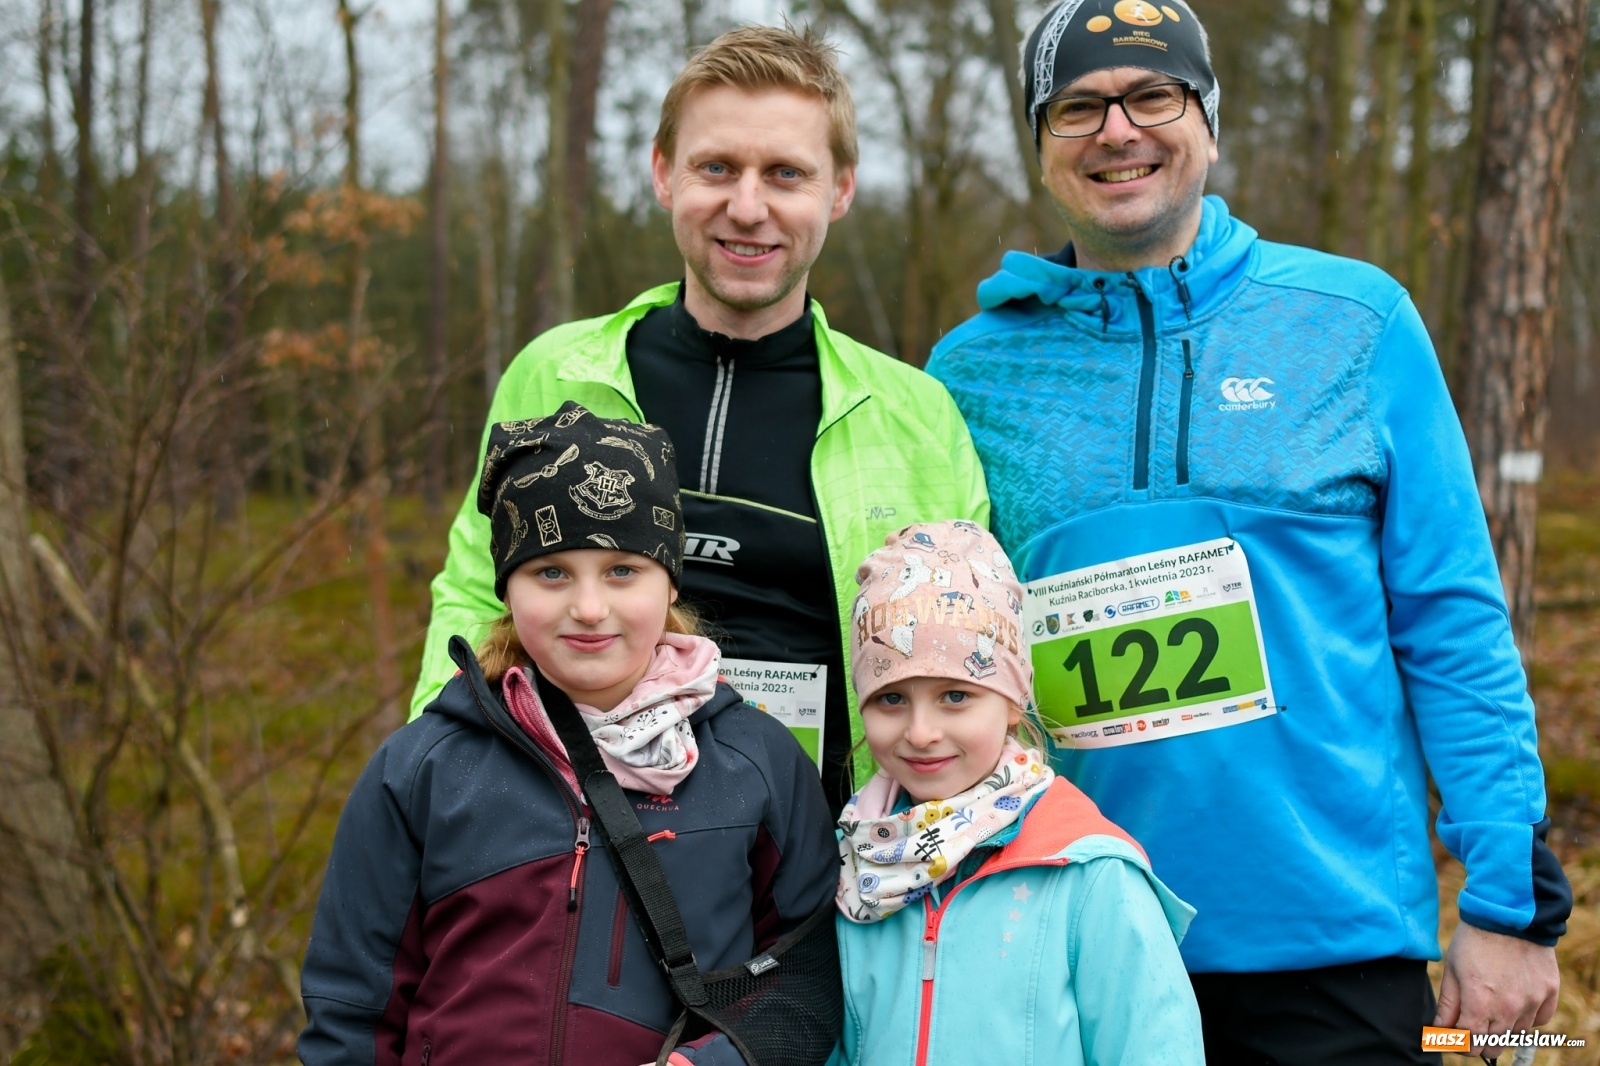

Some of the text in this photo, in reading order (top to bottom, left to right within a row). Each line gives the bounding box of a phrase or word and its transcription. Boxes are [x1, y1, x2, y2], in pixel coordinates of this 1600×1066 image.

[1219, 401, 1276, 411] canterbury
[865, 506, 897, 520] MP
[1033, 546, 1231, 597] VIII Kuźniański Półmaraton Leśny RAFAMET
[1049, 592, 1077, 607] Kuźnia
[1078, 583, 1128, 600] Raciborska,
[1135, 572, 1177, 587] kwietnia
[1180, 565, 1206, 579] 2023
[1207, 565, 1214, 573] r.
[1122, 600, 1156, 612] RAFAMET
[857, 595, 1019, 655] HOGWARTS
[734, 667, 762, 680] Leśny
[765, 670, 813, 681] RAFAMET
[1063, 617, 1231, 718] 122
[731, 680, 796, 694] ietnia 2023 r.
[636, 803, 680, 811] QUECHUA
